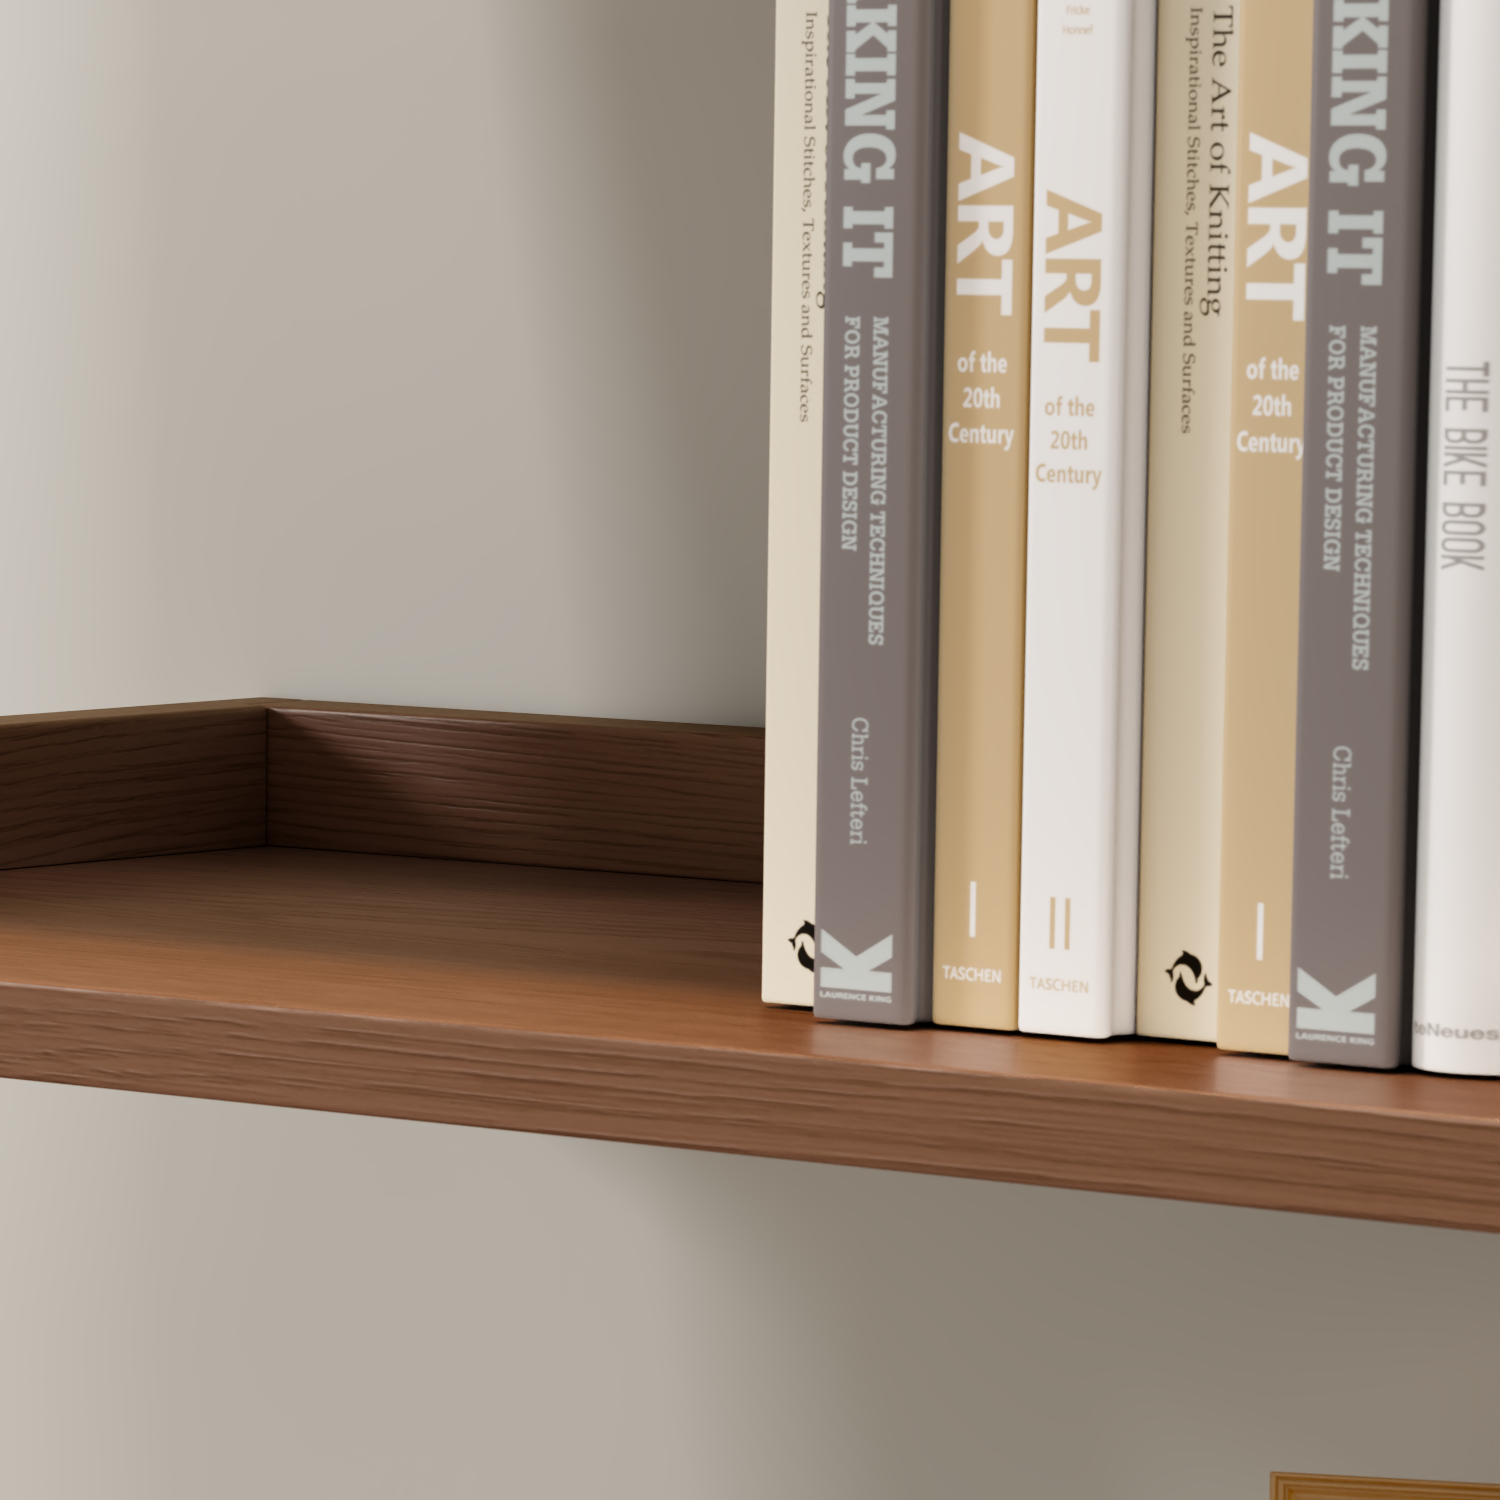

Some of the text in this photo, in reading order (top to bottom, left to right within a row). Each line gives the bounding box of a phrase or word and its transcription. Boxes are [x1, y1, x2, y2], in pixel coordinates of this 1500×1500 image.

[842, 0, 897, 278] KING IT
[1198, 5, 1234, 317] The Art of Knitting
[799, 12, 818, 423] Inspirational Stitches, Textures and Surfaces
[955, 131, 1016, 317] ART
[1180, 7, 1204, 434] Inspirational Stitches, Textures and Surfaces
[1245, 131, 1310, 322] ART
[1327, 210, 1384, 286] IT
[1043, 190, 1103, 363] ART
[956, 349, 1008, 374] of the
[962, 385, 1002, 410] 20th
[1245, 356, 1300, 381] of the
[840, 315, 862, 552] FOR PRODUCT DESIGN
[947, 421, 1015, 452] Century
[1044, 395, 1096, 418] of the
[1050, 429, 1088, 451] 20th
[1251, 393, 1293, 418] 20th
[867, 315, 890, 646] MANUFACTURING TECHNIQUES
[1035, 462, 1103, 491] Century
[1235, 429, 1305, 461] Century
[1322, 324, 1347, 573] FOR PRODUCT DESIGN
[1441, 360, 1492, 571] THE BIKE BOOK
[1350, 325, 1379, 672] MANUFACTURING TECHNIQUES
[849, 716, 870, 845] Chris Lefteri
[1329, 745, 1353, 880] Chris Lefteri
[819, 928, 894, 994] K
[941, 964, 1003, 984] TASCHEN
[1029, 976, 1090, 994] TASCHEN
[1226, 987, 1291, 1008] TASCHEN
[1295, 966, 1378, 1036] K
